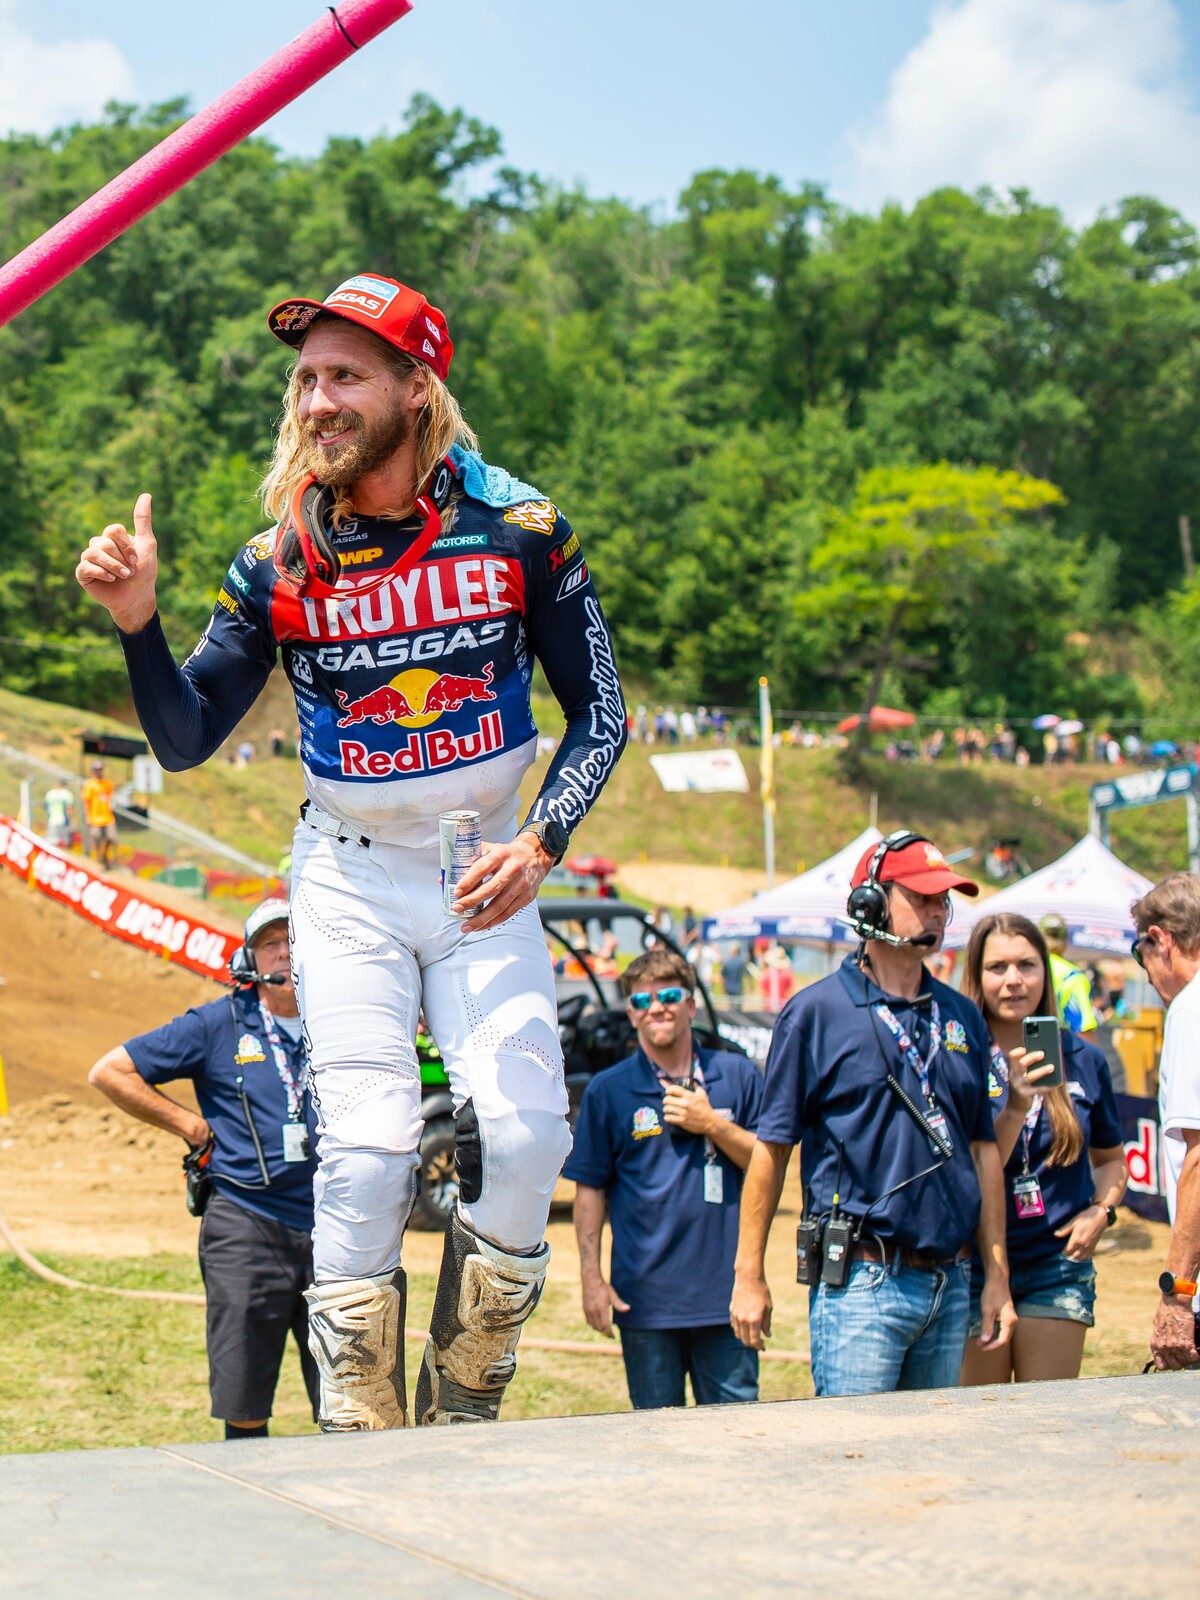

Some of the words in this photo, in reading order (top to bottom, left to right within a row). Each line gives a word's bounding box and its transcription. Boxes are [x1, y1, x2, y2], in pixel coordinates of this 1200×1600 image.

[338, 547, 384, 566] WP
[432, 534, 485, 549] MOTOREX
[427, 559, 512, 622] LEE
[316, 621, 507, 672] GASGAS
[338, 733, 425, 778] Red
[425, 709, 504, 770] Bull
[115, 898, 189, 953] LUCAS
[185, 927, 227, 970] OIL
